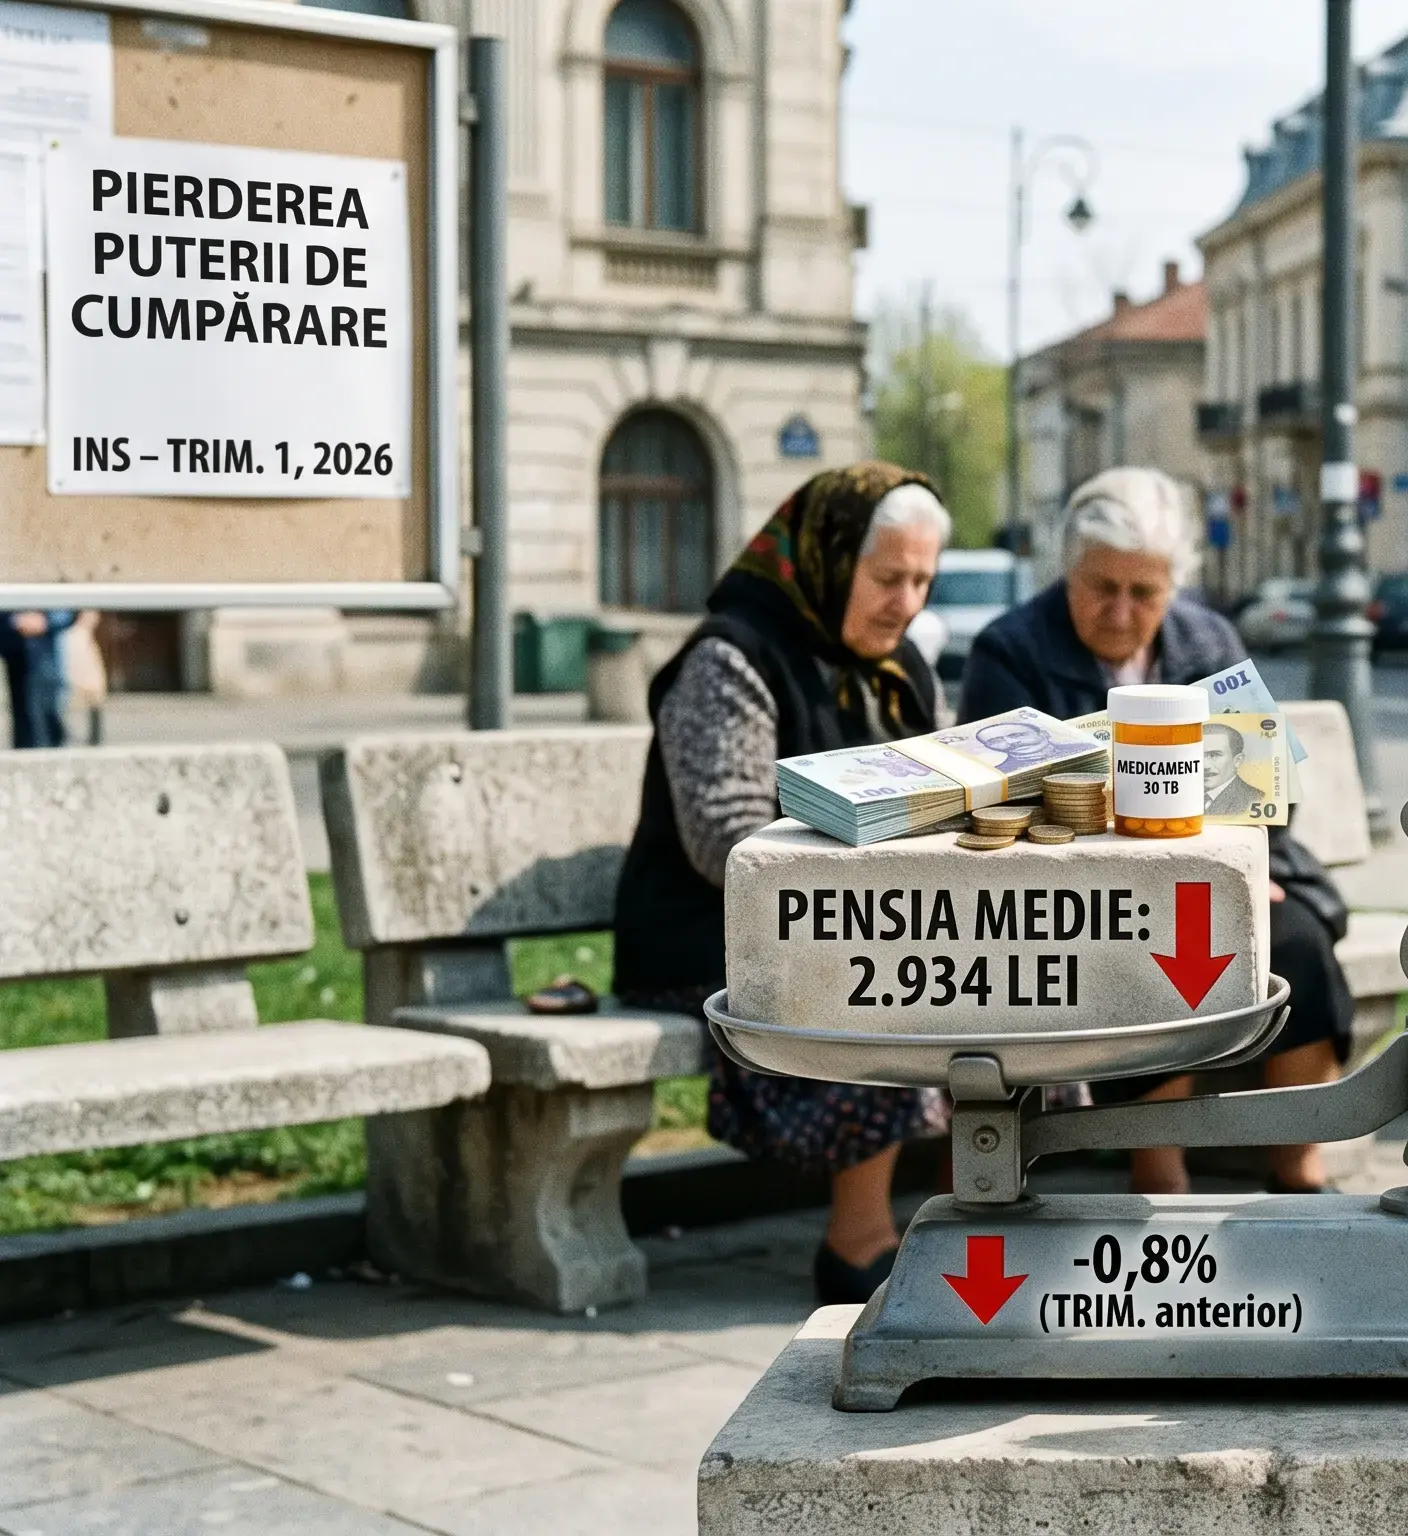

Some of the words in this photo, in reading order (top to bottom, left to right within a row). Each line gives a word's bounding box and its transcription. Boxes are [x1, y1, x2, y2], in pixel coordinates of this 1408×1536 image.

[92, 169, 370, 230] PIERDEREA
[94, 232, 290, 284] PUTERII
[306, 245, 368, 289] DE
[71, 291, 388, 348] CUMPĂRARE
[73, 436, 131, 472] INS
[166, 438, 264, 474] TRIM.
[274, 441, 304, 480] 1,
[313, 442, 394, 476] 2026
[1117, 759, 1200, 776] MEDICAMENT
[1143, 781, 1160, 795] 30
[1161, 780, 1179, 795] TB
[1249, 802, 1278, 819] 50
[777, 888, 960, 941] PENSIA
[974, 888, 1151, 941] MEDIE:
[848, 955, 992, 1007] 2.934
[1007, 954, 1078, 1007] LEI
